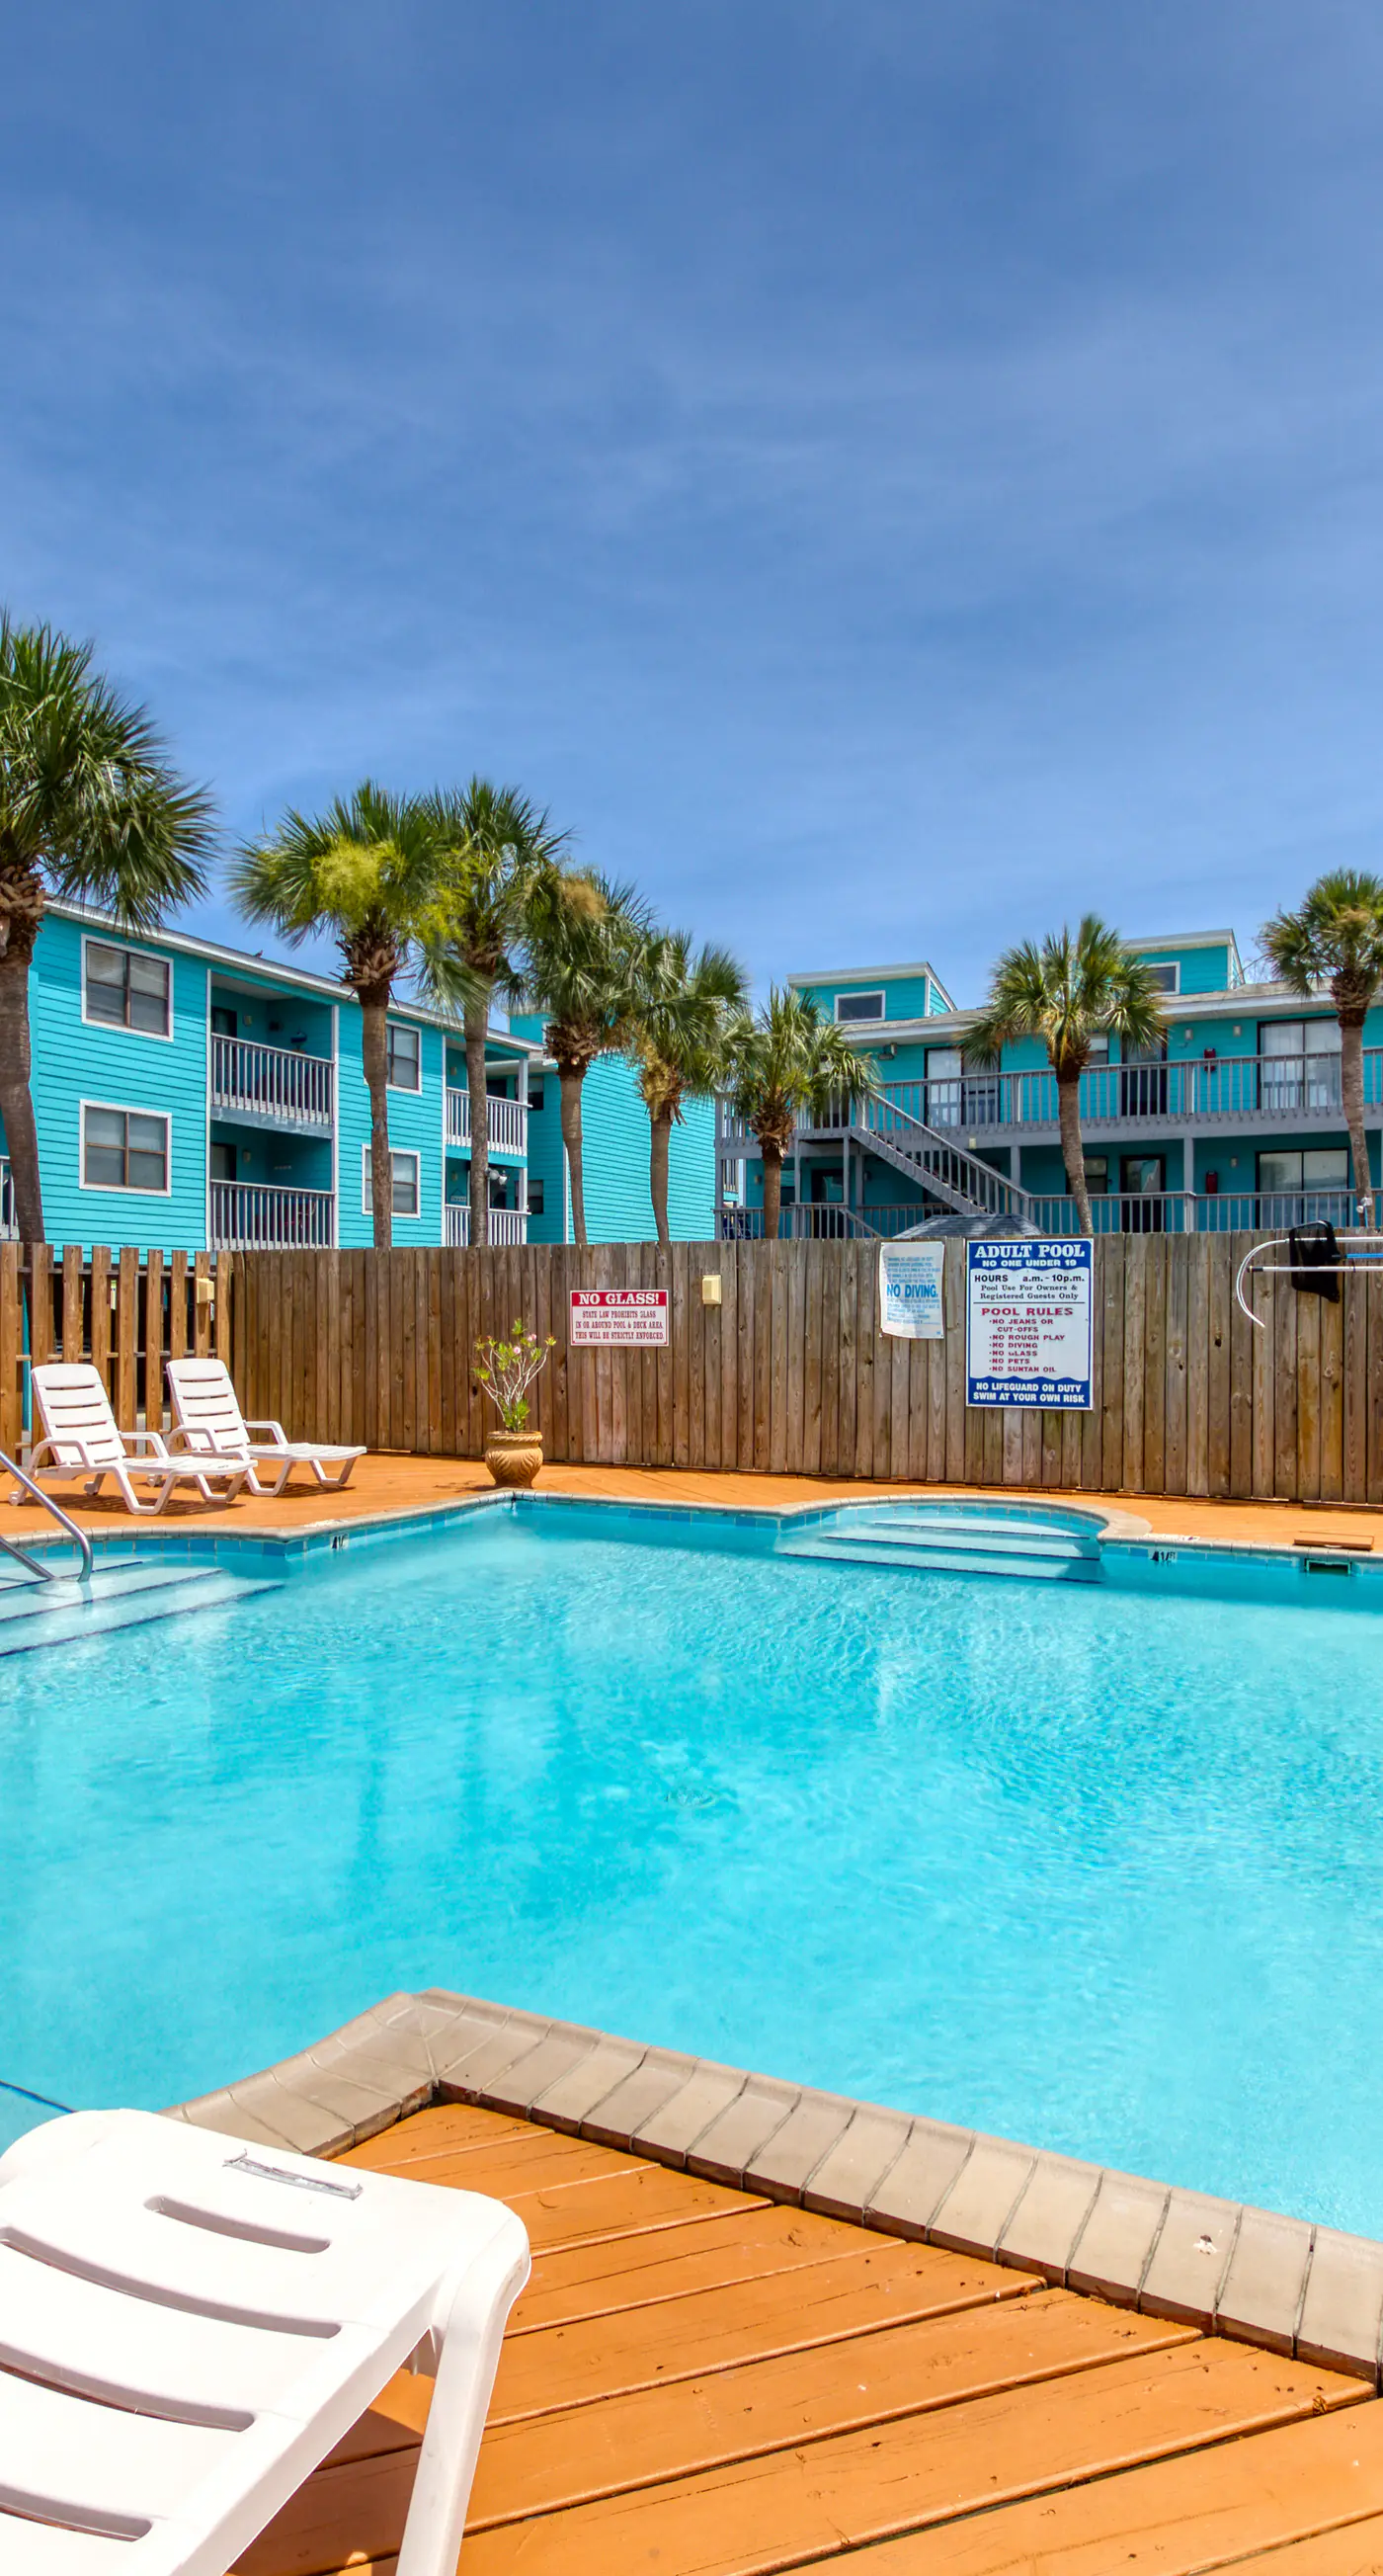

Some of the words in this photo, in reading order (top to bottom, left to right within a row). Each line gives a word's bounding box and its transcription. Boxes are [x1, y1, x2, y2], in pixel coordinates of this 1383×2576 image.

[975, 1245, 1031, 1258] ADULT
[1038, 1244, 1085, 1258] POOL
[886, 1285, 900, 1297] NO
[905, 1285, 938, 1297] DIVING.
[579, 1293, 601, 1304] NO
[606, 1292, 659, 1304] GLASS!
[982, 1307, 1019, 1316] POOL
[1026, 1307, 1074, 1316] RULES
[1063, 1394, 1085, 1403] RISK
